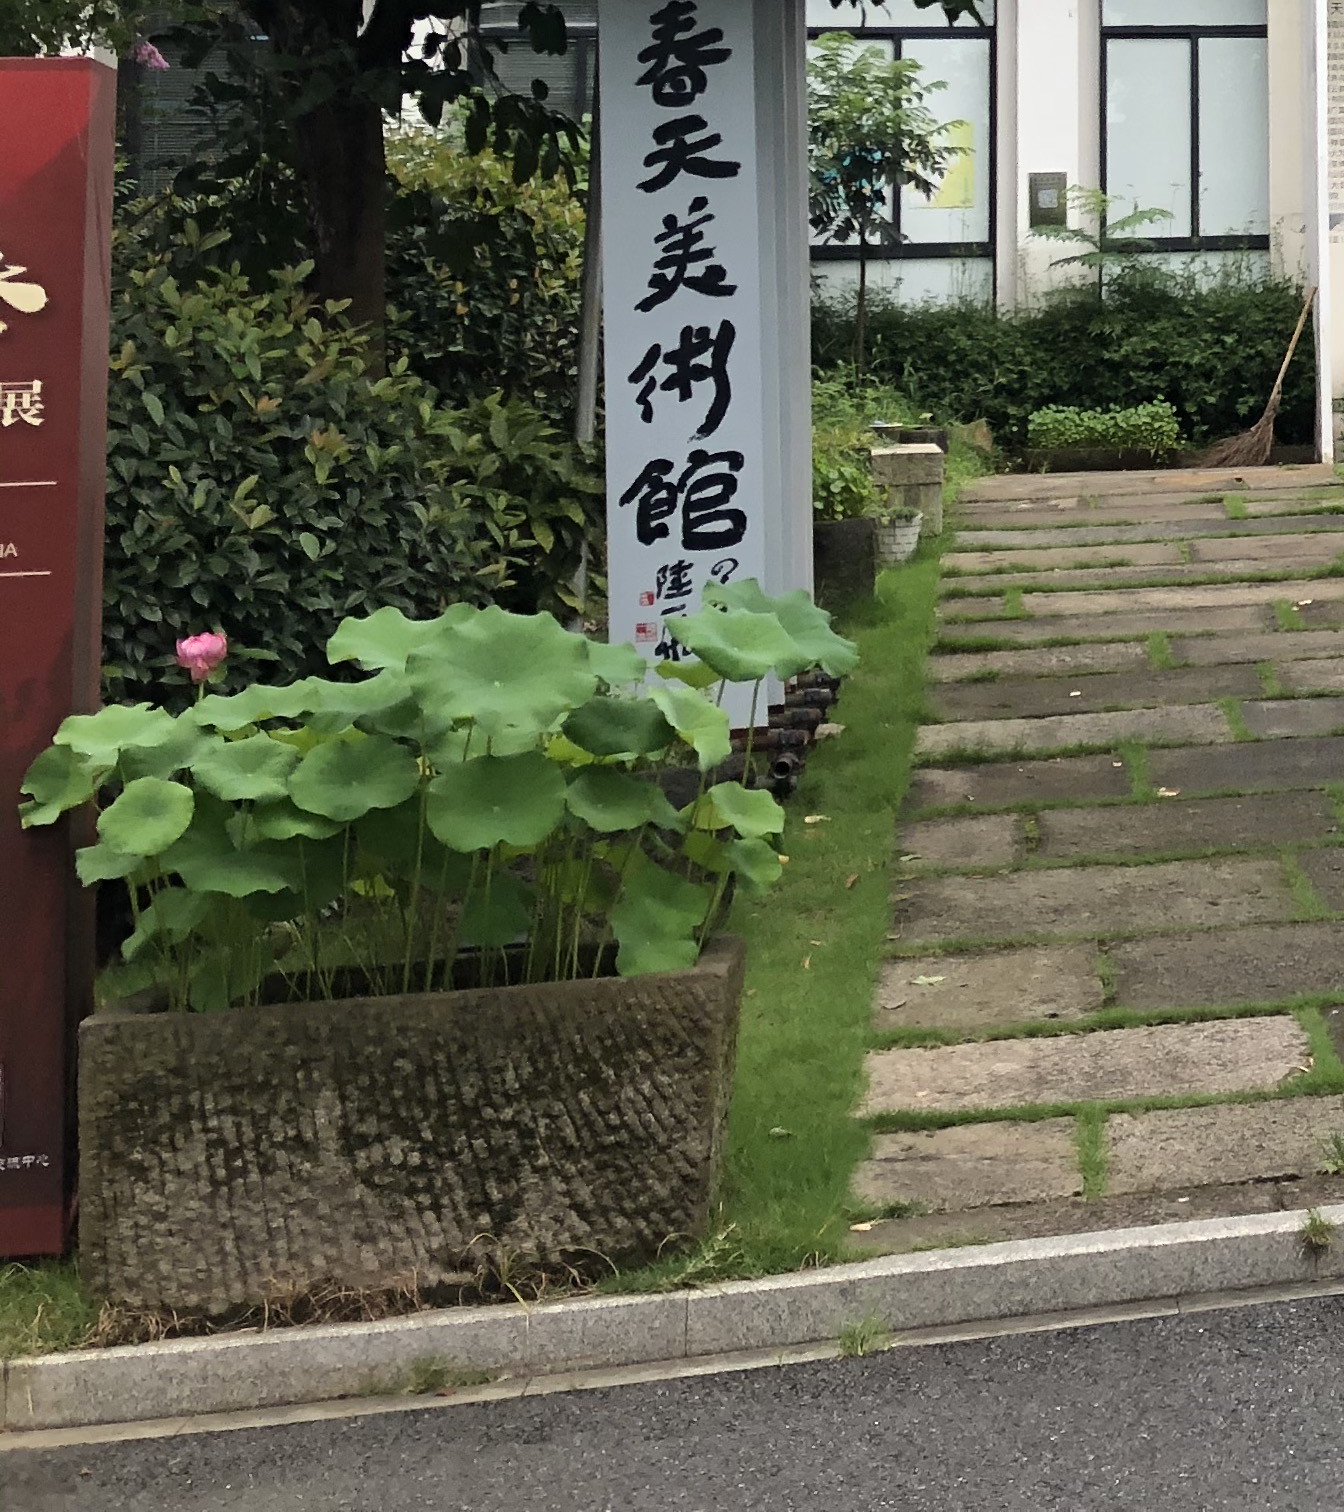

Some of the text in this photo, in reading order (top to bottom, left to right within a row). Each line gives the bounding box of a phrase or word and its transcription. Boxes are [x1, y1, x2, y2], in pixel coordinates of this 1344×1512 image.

[617, 0, 747, 551] 春天美術館
